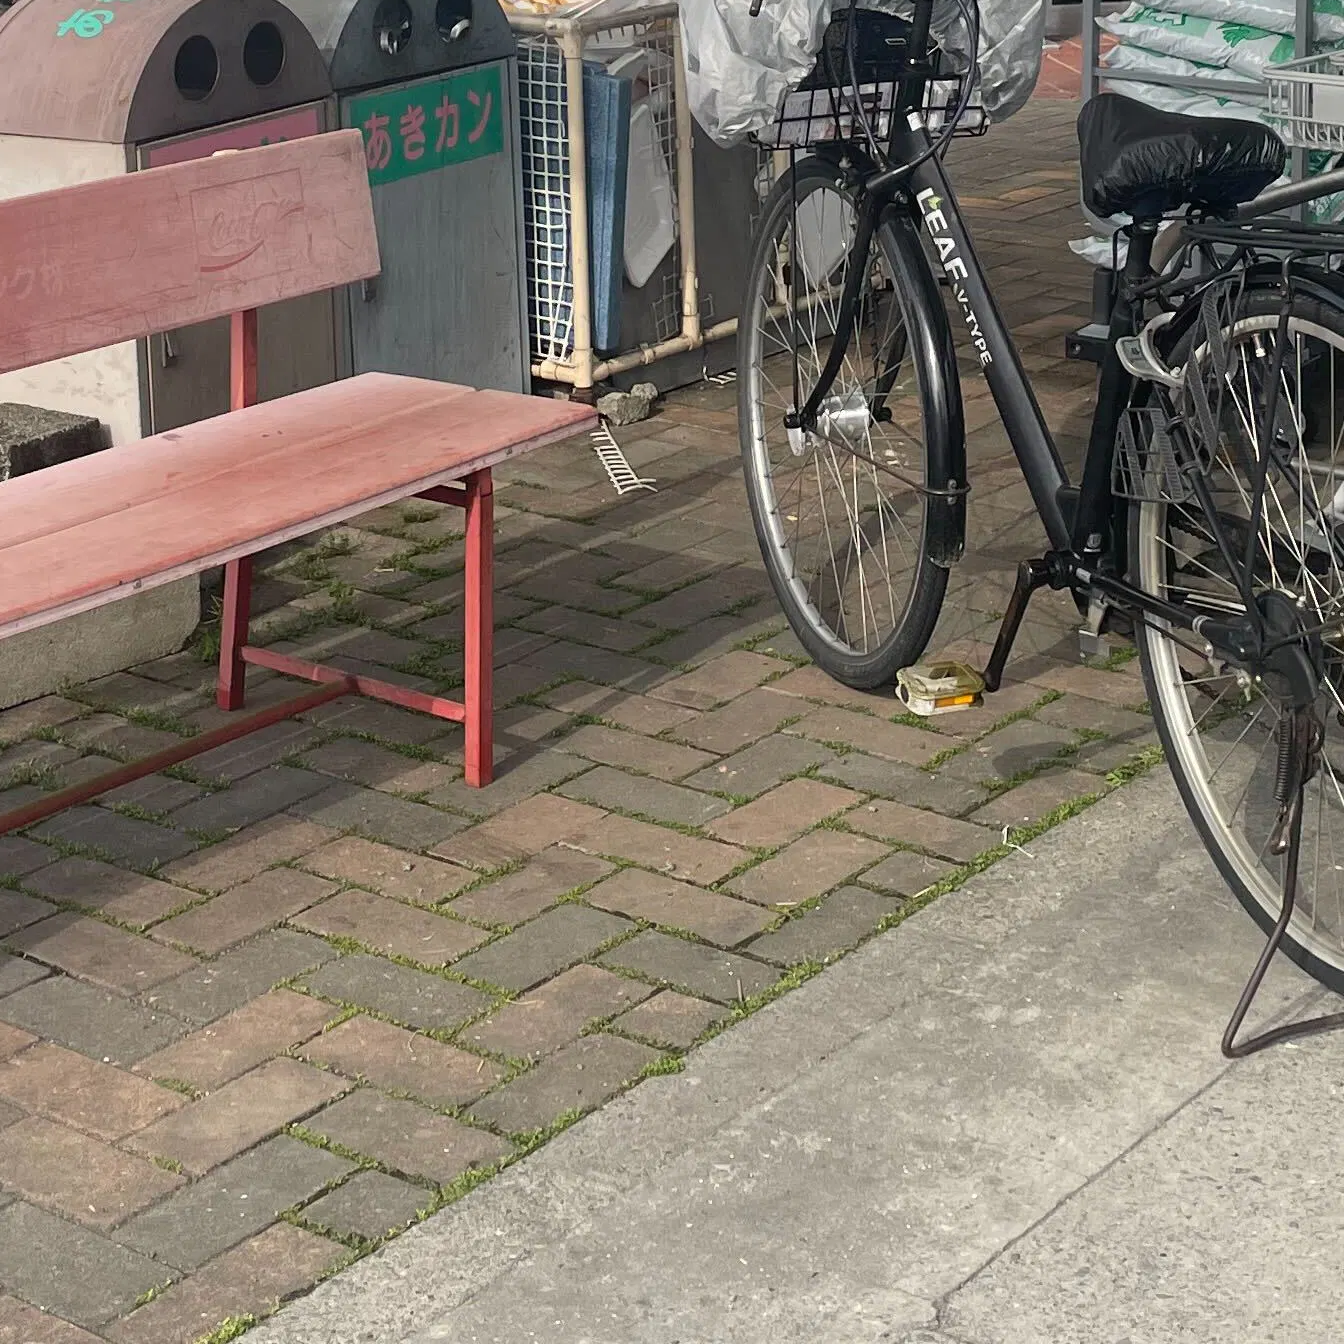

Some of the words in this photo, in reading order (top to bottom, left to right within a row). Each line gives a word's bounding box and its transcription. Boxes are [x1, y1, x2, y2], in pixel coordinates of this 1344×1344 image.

[364, 87, 495, 171] あきカン
[916, 187, 969, 281] LEAF
[956, 288, 993, 367] V-TYPE
